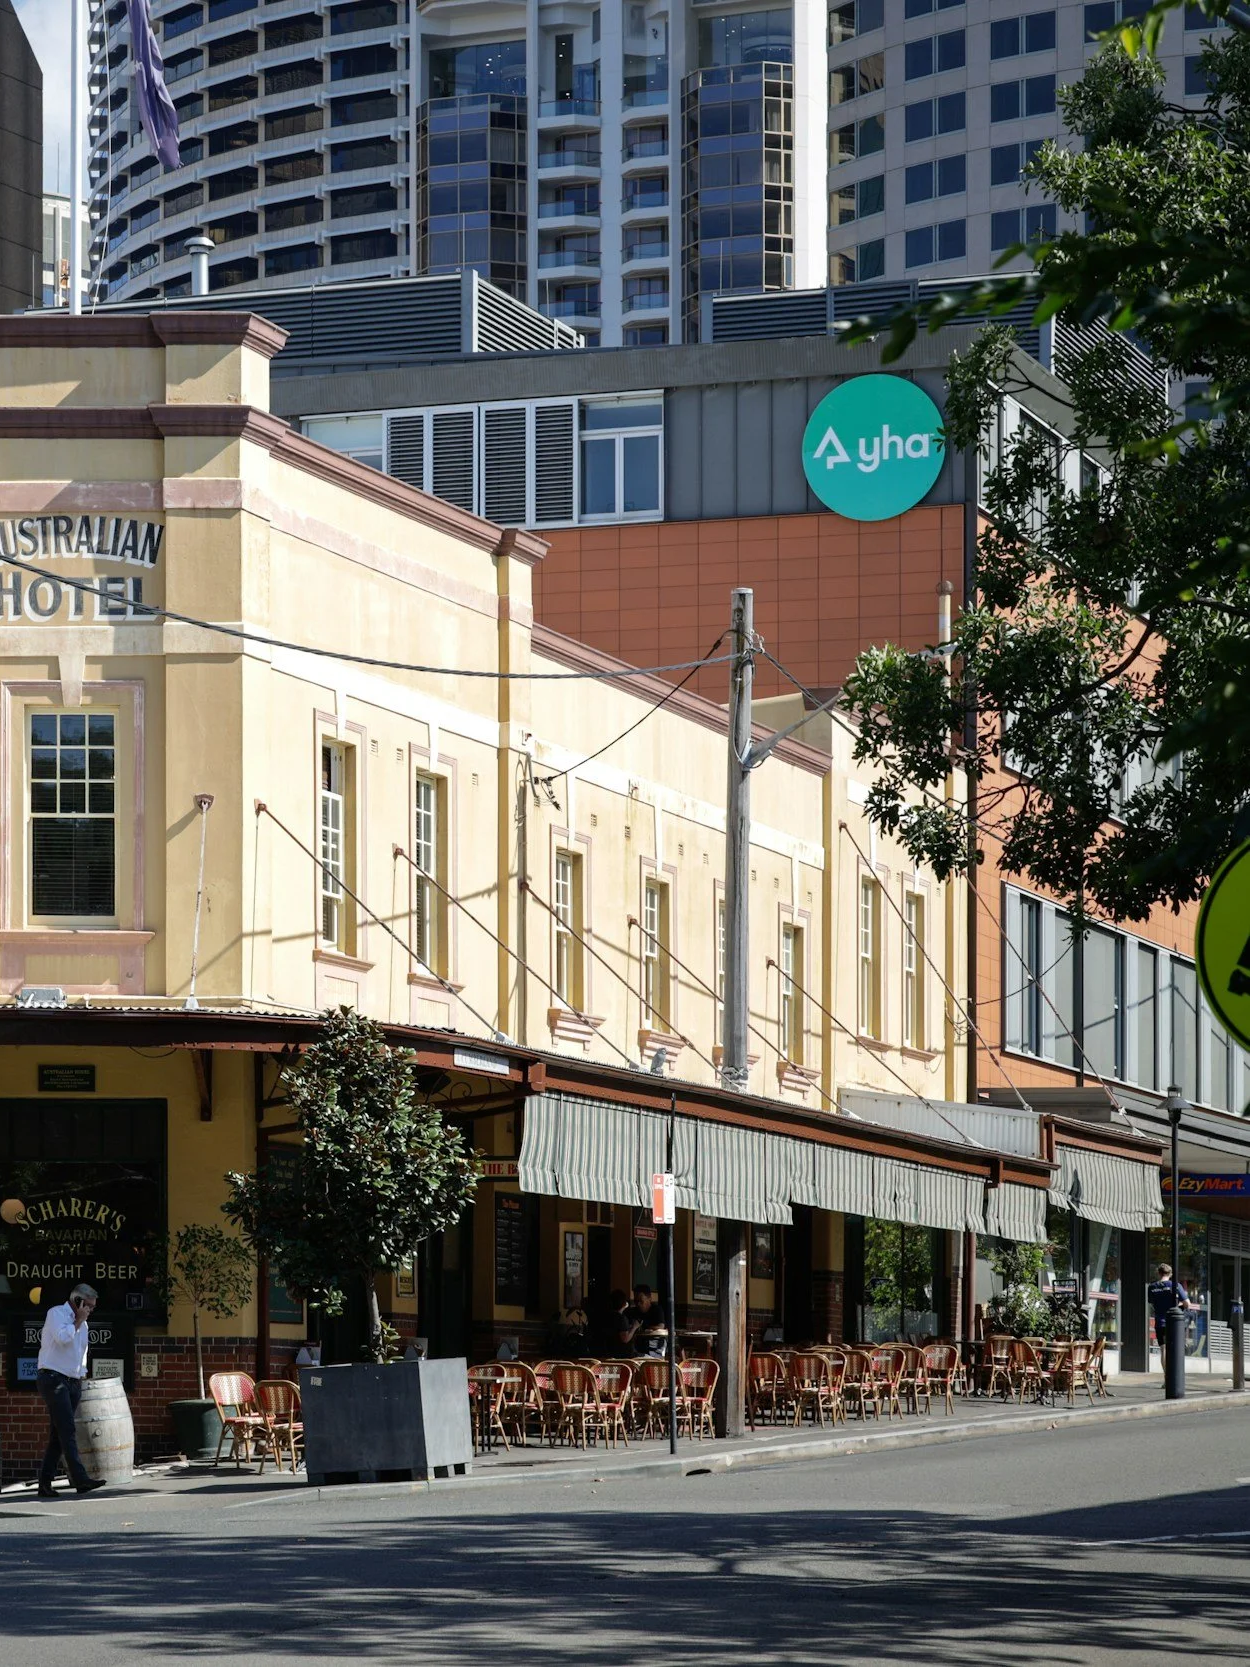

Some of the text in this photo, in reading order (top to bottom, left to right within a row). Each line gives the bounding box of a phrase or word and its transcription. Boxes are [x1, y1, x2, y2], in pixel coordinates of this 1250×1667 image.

[857, 424, 930, 473] yha
[15, 1197, 126, 1232] SCHARER'S
[34, 1229, 108, 1241] BAVARIAN
[48, 1243, 95, 1256] STYLE
[6, 1261, 138, 1280] DRAUGHT BEER
